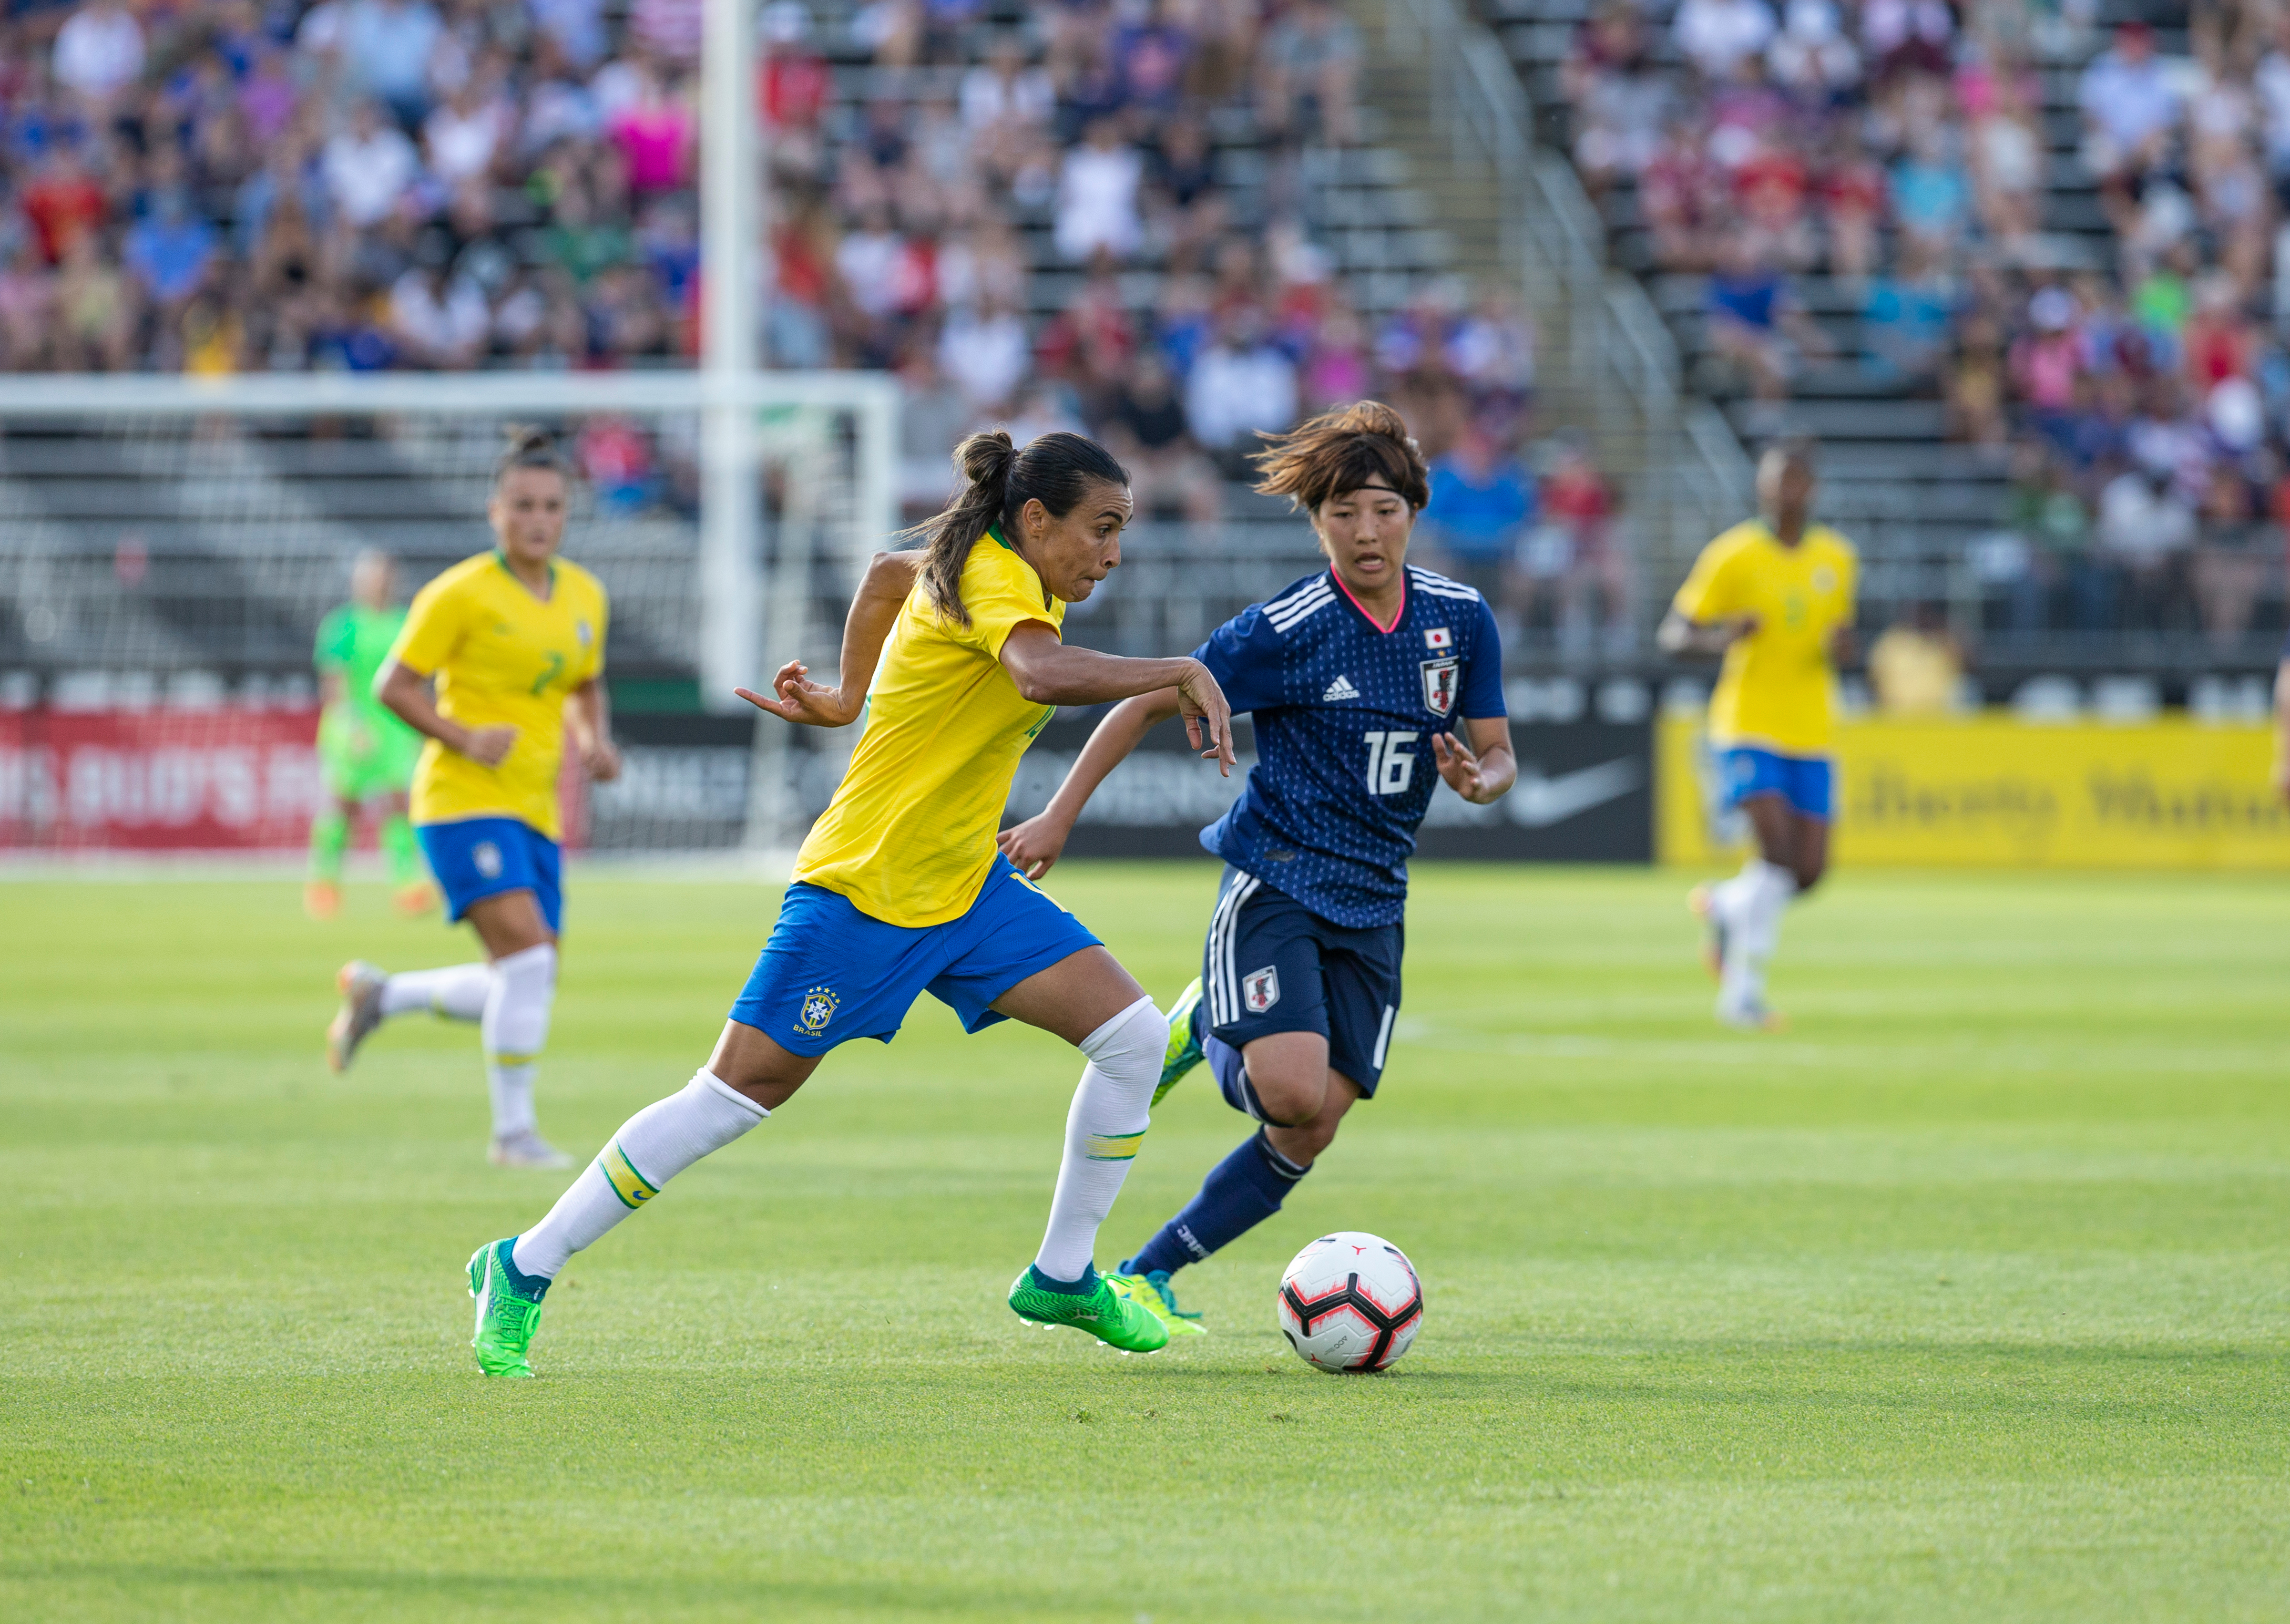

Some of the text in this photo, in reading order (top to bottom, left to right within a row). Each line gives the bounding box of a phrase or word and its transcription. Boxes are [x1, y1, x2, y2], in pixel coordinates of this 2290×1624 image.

[528, 650, 566, 698] 7
[1322, 688, 1361, 703] adidas
[1363, 731, 1420, 796] 16
[793, 1024, 822, 1036] BRASIL
